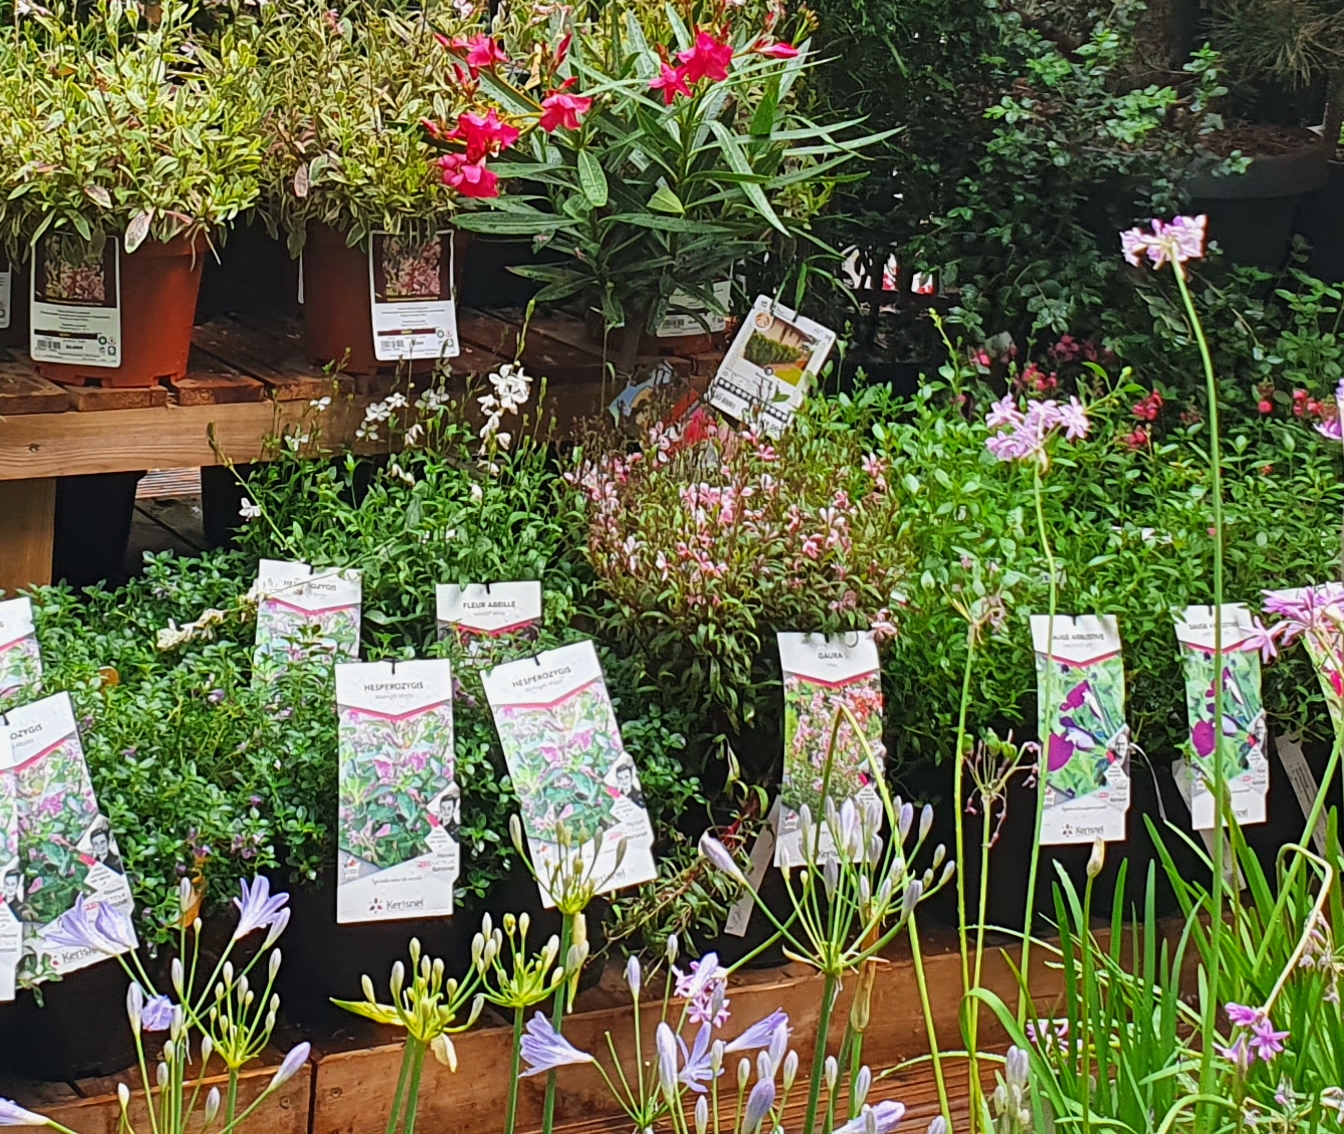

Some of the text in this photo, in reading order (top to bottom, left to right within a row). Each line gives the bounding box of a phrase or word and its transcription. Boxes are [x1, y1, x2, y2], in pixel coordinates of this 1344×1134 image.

[512, 666, 572, 688] HESPEROZYGIS
[364, 681, 424, 692] HESPEROZYGIS
[10, 723, 43, 740] OZYGIS
[386, 899, 424, 910] Kerisnel
